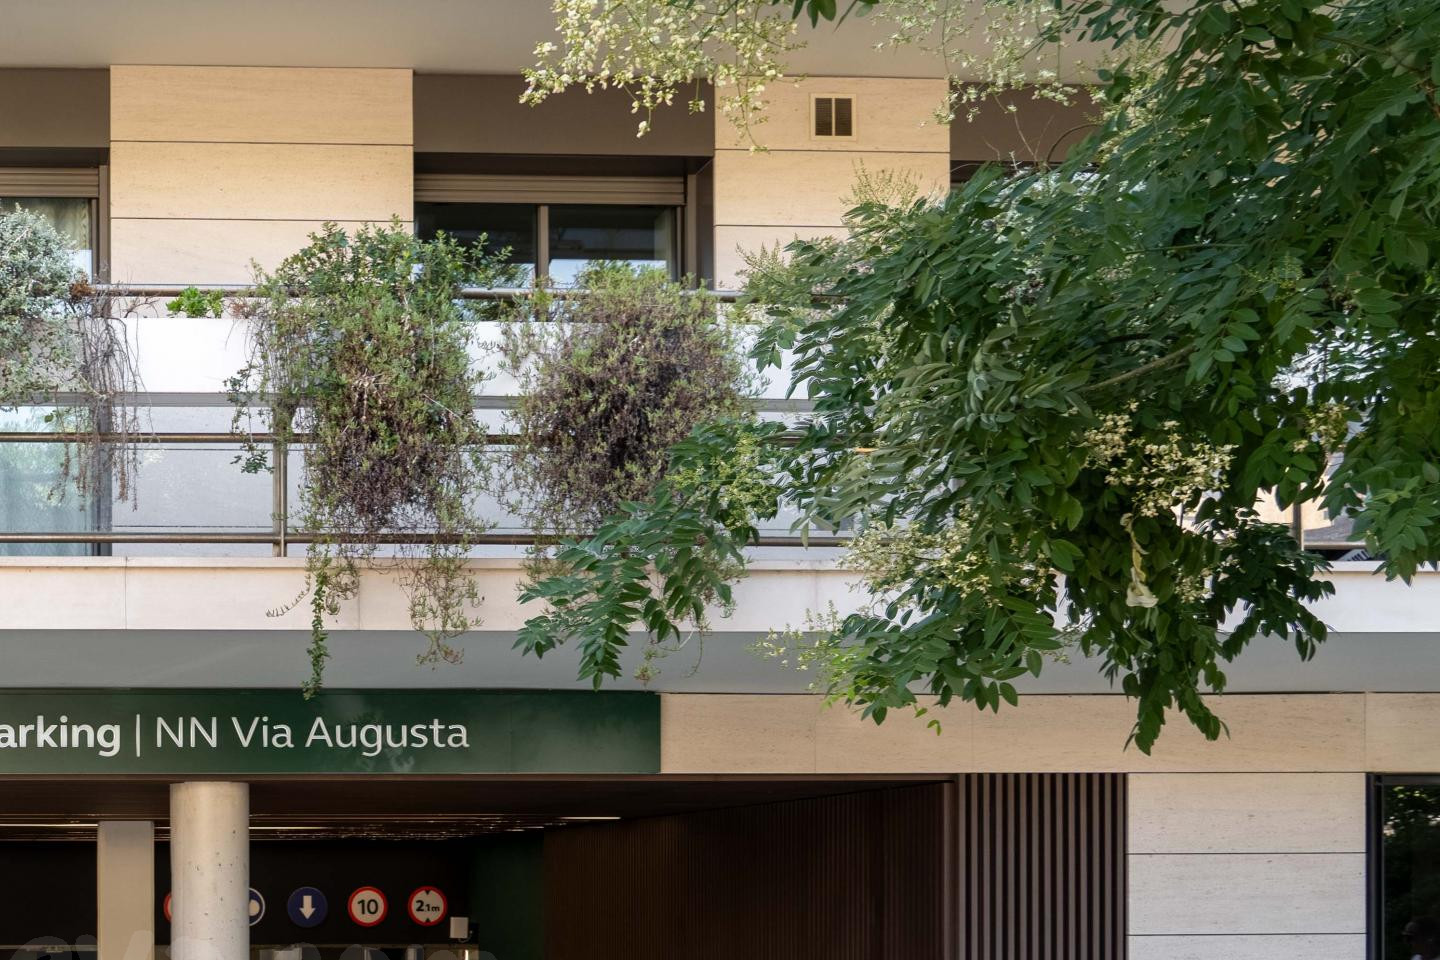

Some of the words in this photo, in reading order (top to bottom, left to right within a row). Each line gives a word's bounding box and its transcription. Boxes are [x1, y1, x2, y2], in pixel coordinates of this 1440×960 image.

[156, 716, 217, 748] NN
[231, 716, 294, 748] Via
[305, 716, 470, 757] Augusta
[357, 899, 379, 915] 10
